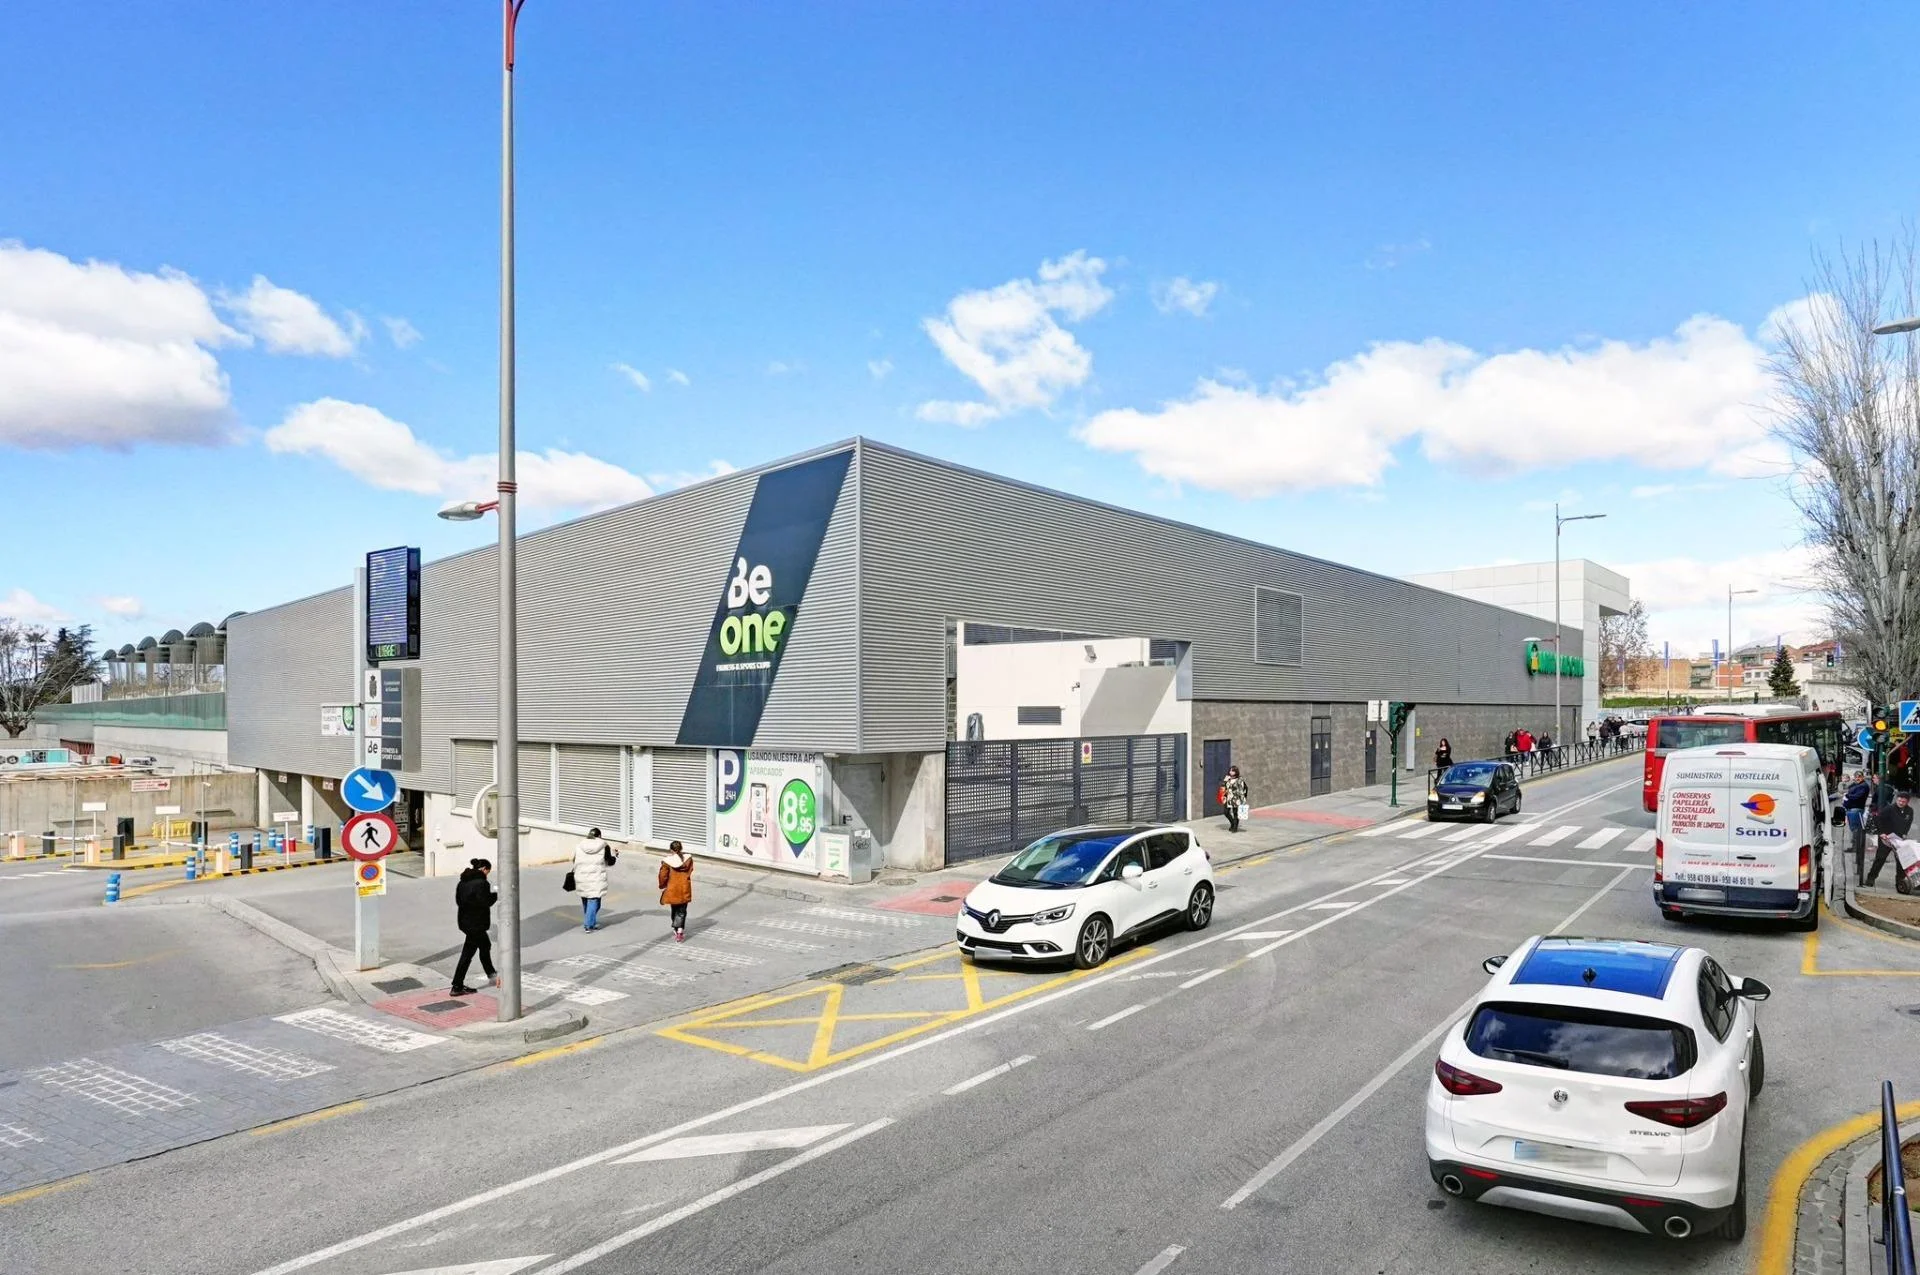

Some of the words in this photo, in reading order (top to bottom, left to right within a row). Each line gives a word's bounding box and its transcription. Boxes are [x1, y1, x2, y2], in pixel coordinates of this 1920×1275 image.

[727, 556, 772, 609] Be
[720, 610, 786, 656] one
[747, 751, 772, 761] USANDO
[773, 752, 803, 763] NUESTRA
[718, 749, 740, 805] P
[1676, 772, 1723, 780] SUMINISTROS
[1734, 773, 1780, 781] HOSTELERÍA
[725, 790, 737, 800] 24H
[1672, 799, 1709, 807] PAPELERÍA
[1672, 806, 1716, 814] CRISTALERÍA
[1735, 827, 1788, 838] SanDi
[1629, 1129, 1671, 1137] STELVIO
